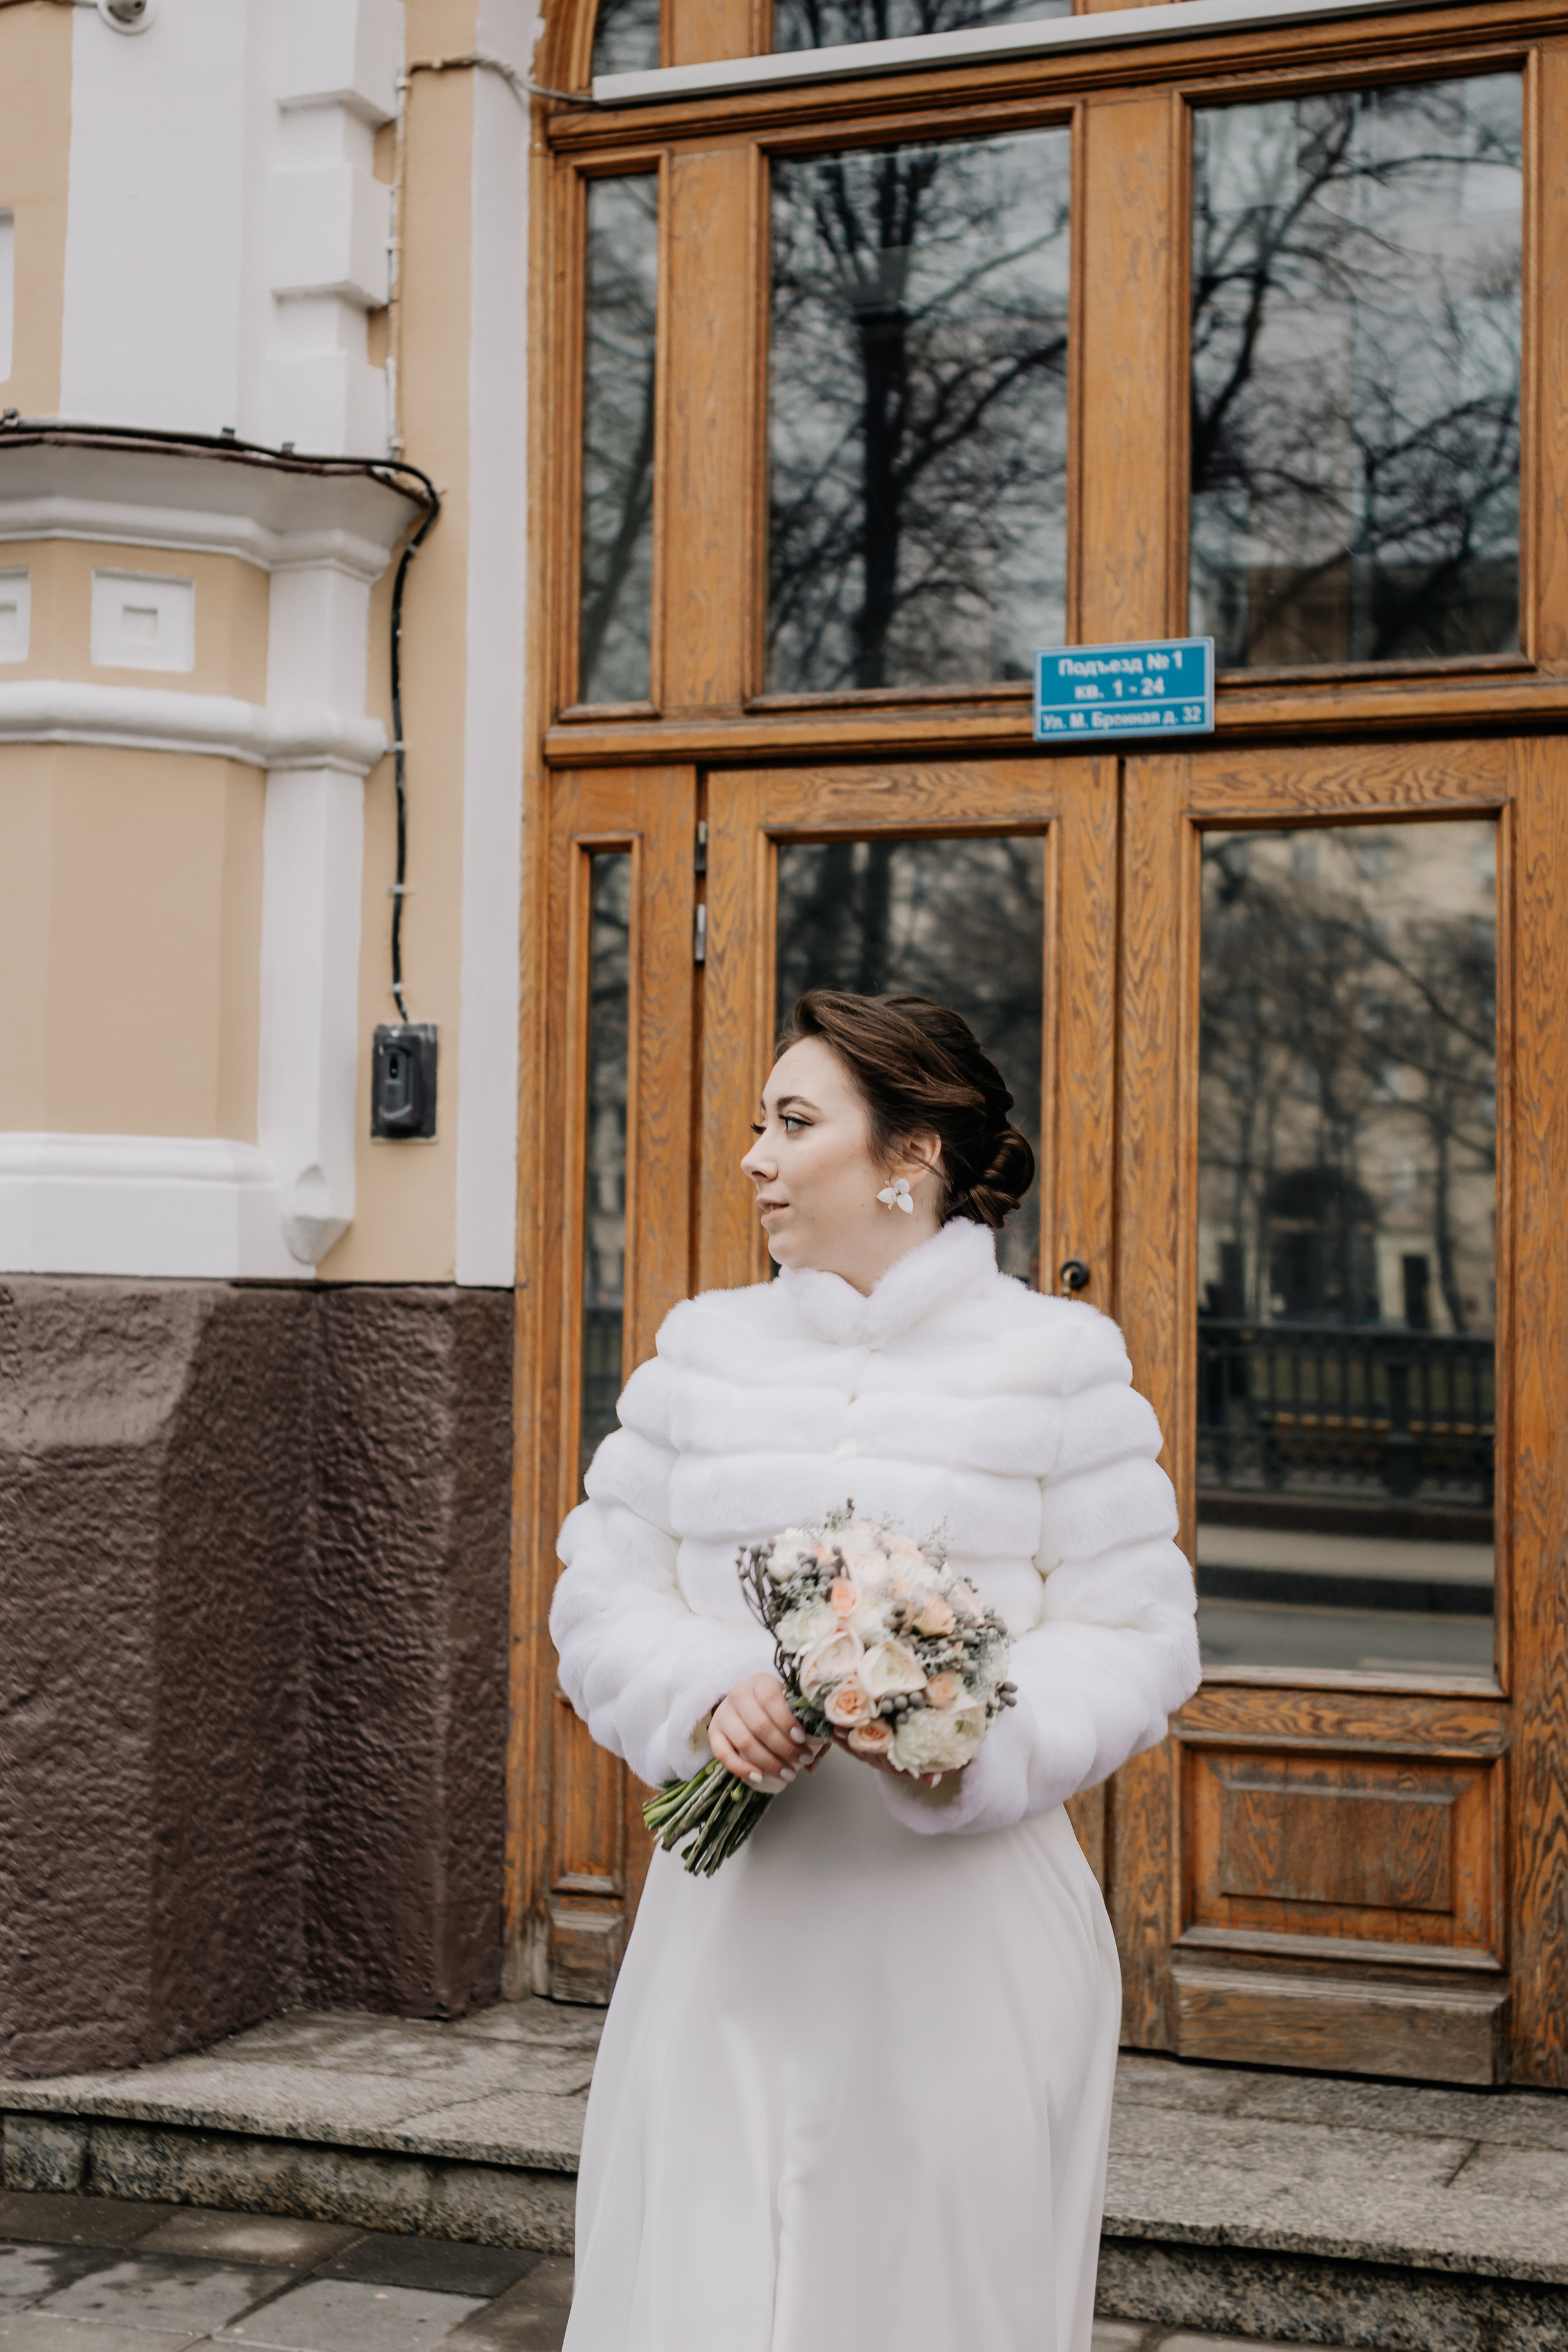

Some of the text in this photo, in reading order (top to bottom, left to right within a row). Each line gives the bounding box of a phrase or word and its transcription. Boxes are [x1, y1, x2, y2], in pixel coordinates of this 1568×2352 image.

[1058, 649, 1183, 677] Подъезд № 1
[1074, 684, 1104, 699] кв.
[1112, 679, 1123, 698] 1
[1140, 676, 1166, 696] 24
[1069, 711, 1088, 728] М.
[1182, 705, 1202, 723] 32
